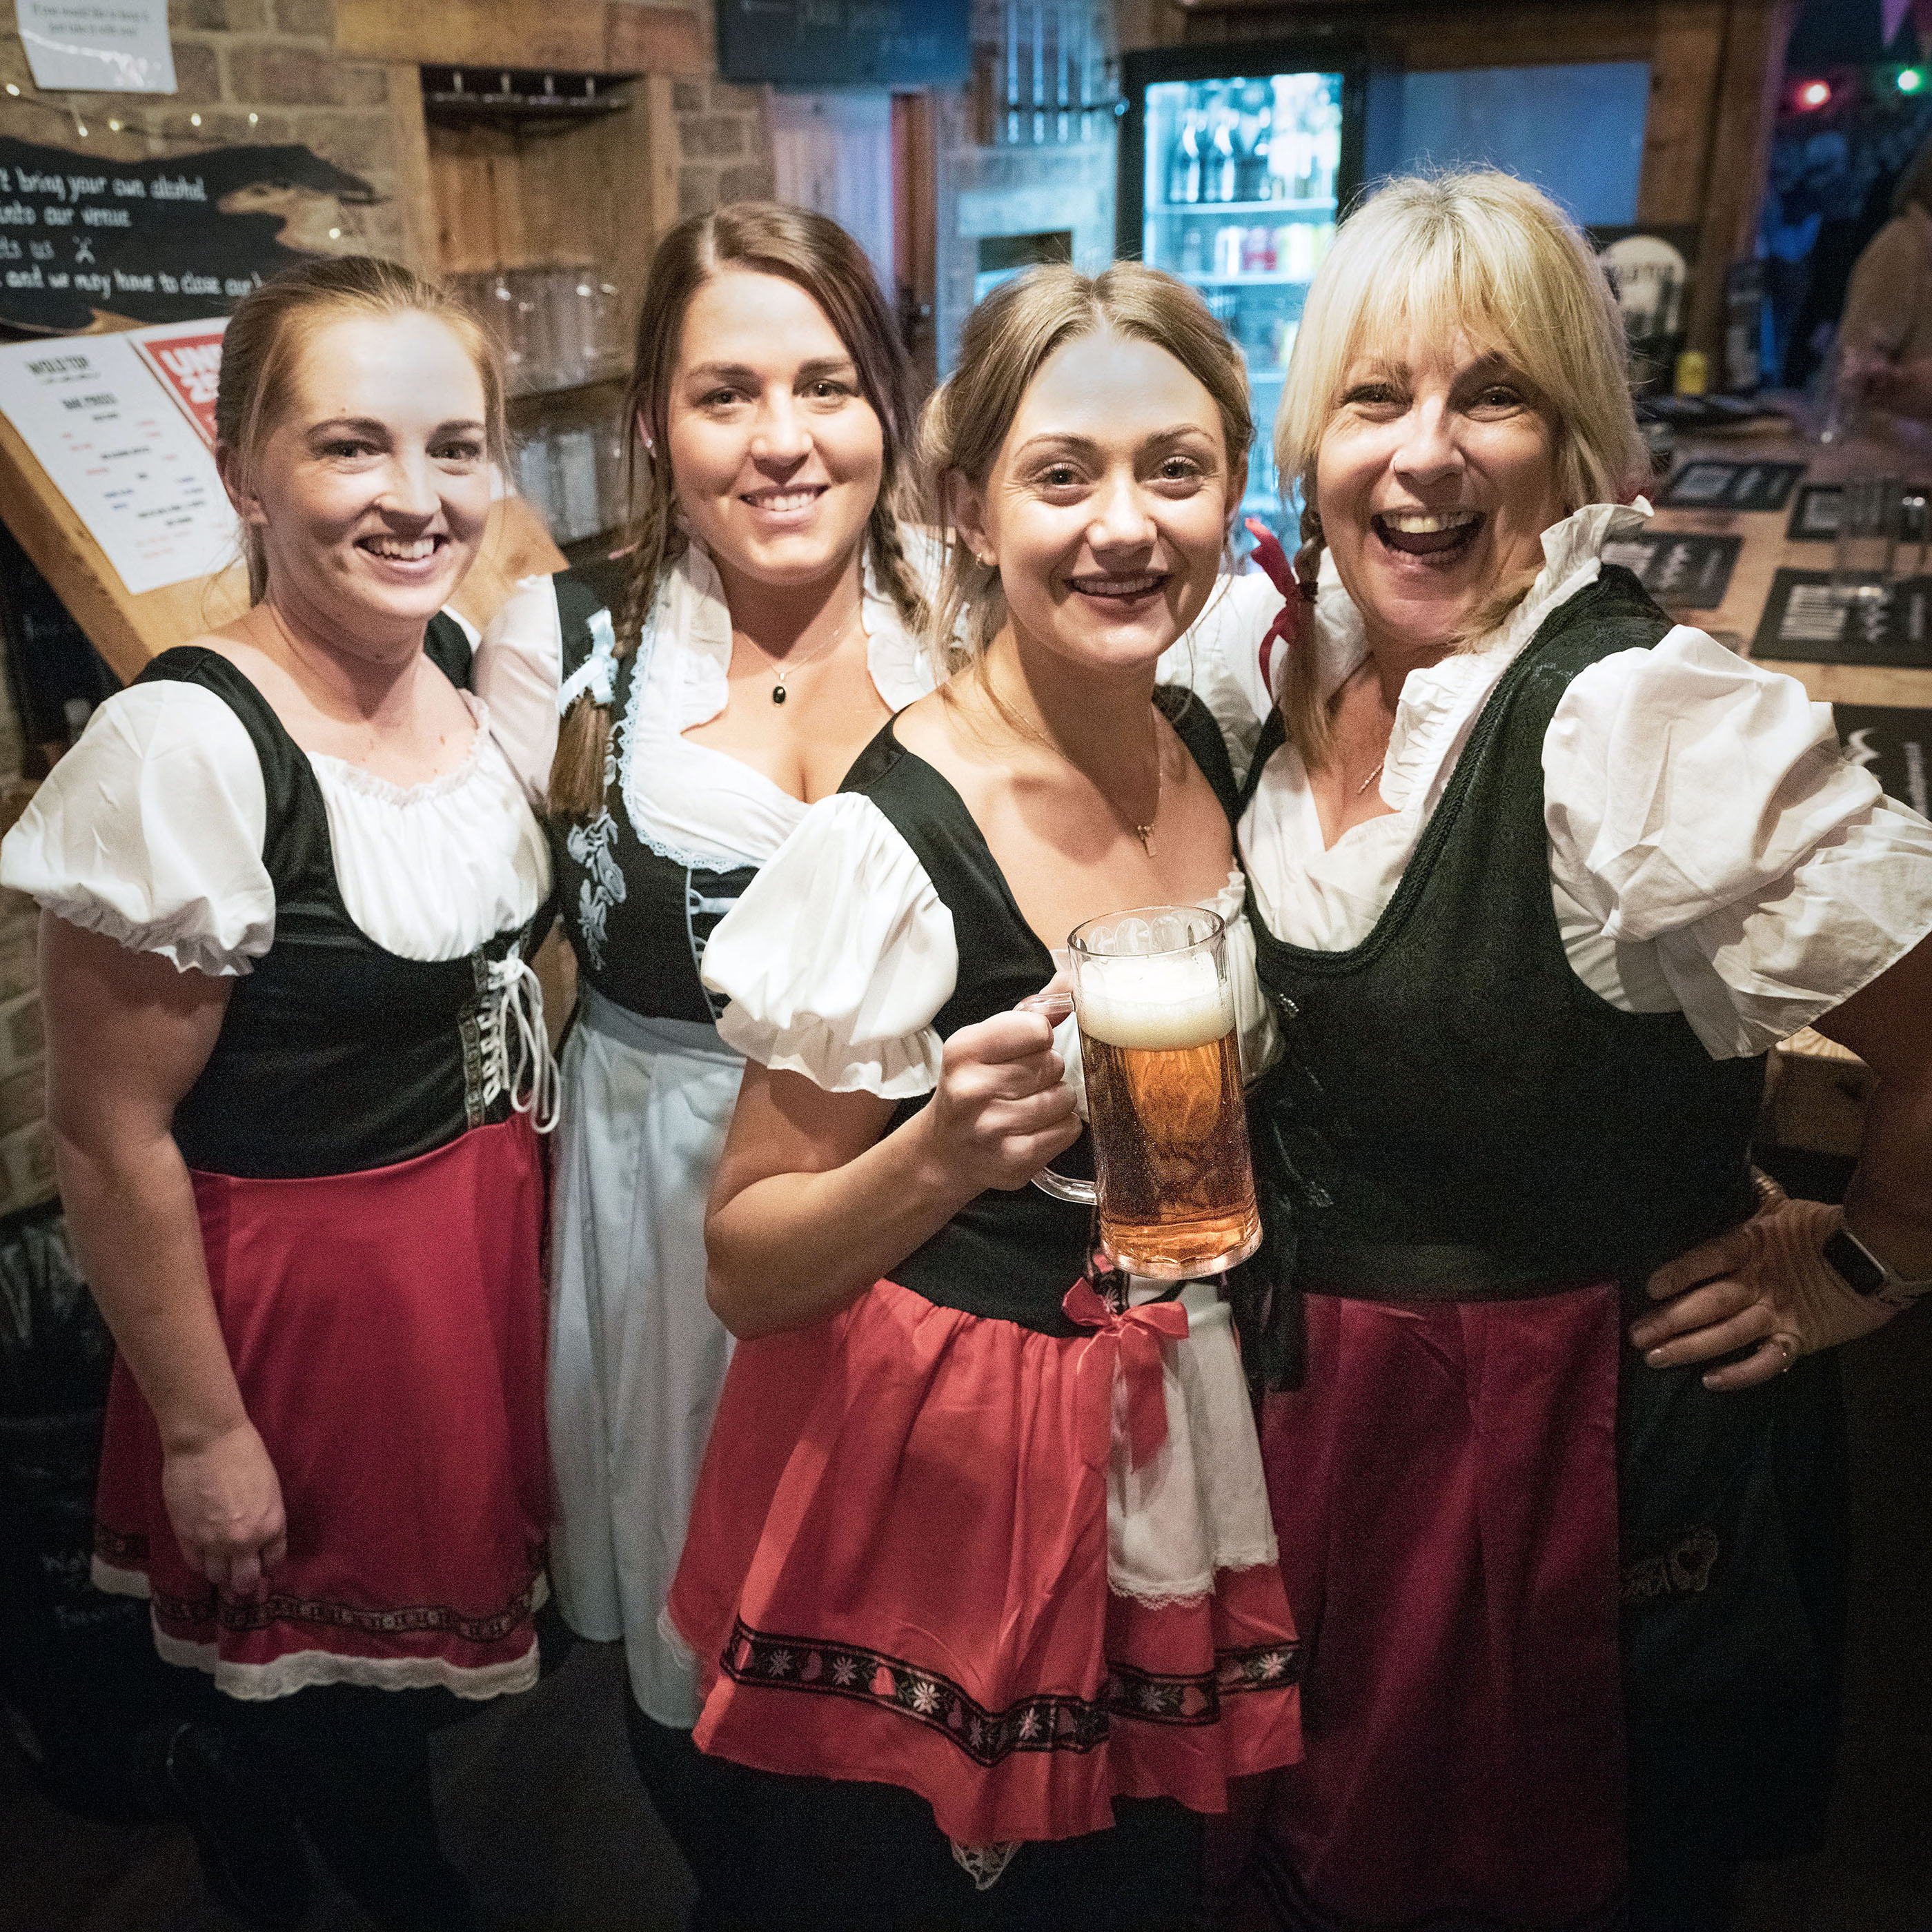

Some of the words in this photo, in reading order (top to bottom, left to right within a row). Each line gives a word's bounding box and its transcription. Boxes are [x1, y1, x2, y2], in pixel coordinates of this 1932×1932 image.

[14, 166, 66, 201] bring
[67, 176, 108, 203] your
[112, 178, 147, 198] own
[150, 174, 208, 201] alcohol
[43, 206, 75, 226] our
[80, 207, 132, 227] venue
[30, 239, 55, 260] us
[6, 264, 44, 288] and
[48, 273, 70, 289] we
[75, 272, 111, 299] may
[113, 268, 155, 293] have
[158, 270, 179, 294] to
[181, 270, 222, 295] close
